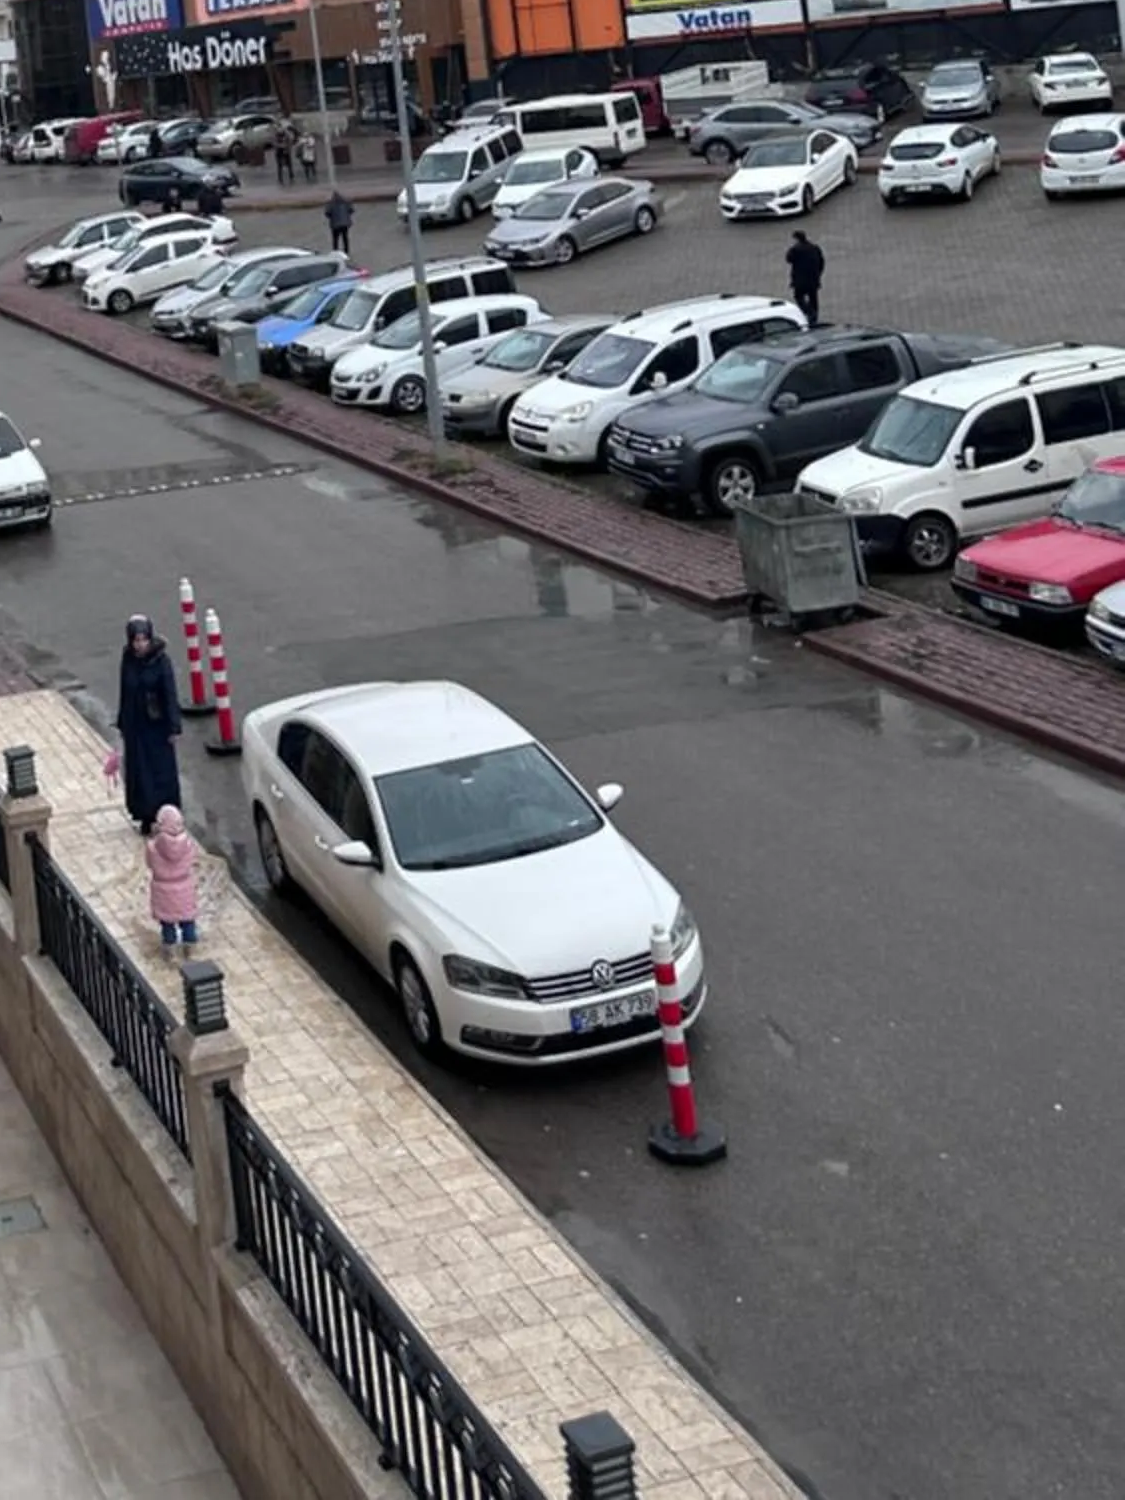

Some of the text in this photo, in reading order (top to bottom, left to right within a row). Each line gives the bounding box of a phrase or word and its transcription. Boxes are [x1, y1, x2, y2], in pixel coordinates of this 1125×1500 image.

[678, 9, 752, 29] Vatan
[167, 31, 266, 73] Has Döner
